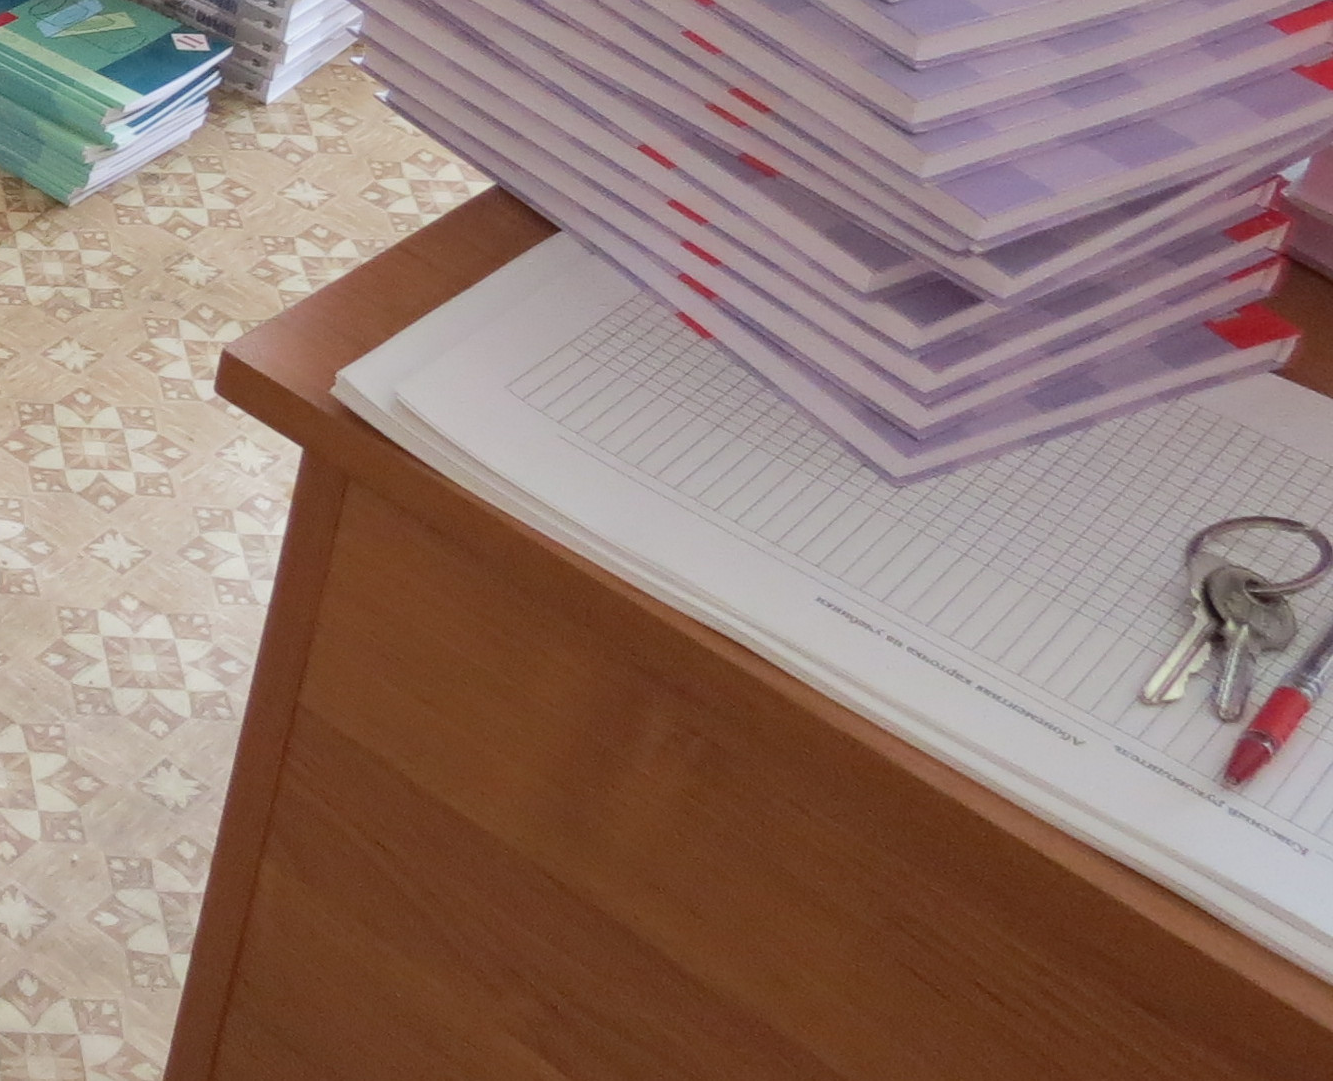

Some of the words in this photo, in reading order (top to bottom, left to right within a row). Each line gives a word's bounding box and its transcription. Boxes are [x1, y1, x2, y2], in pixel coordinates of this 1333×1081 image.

[813, 592, 884, 639] учебники
[883, 633, 903, 650] на
[904, 642, 974, 690] карточка
[1110, 737, 1227, 813] руководитель
